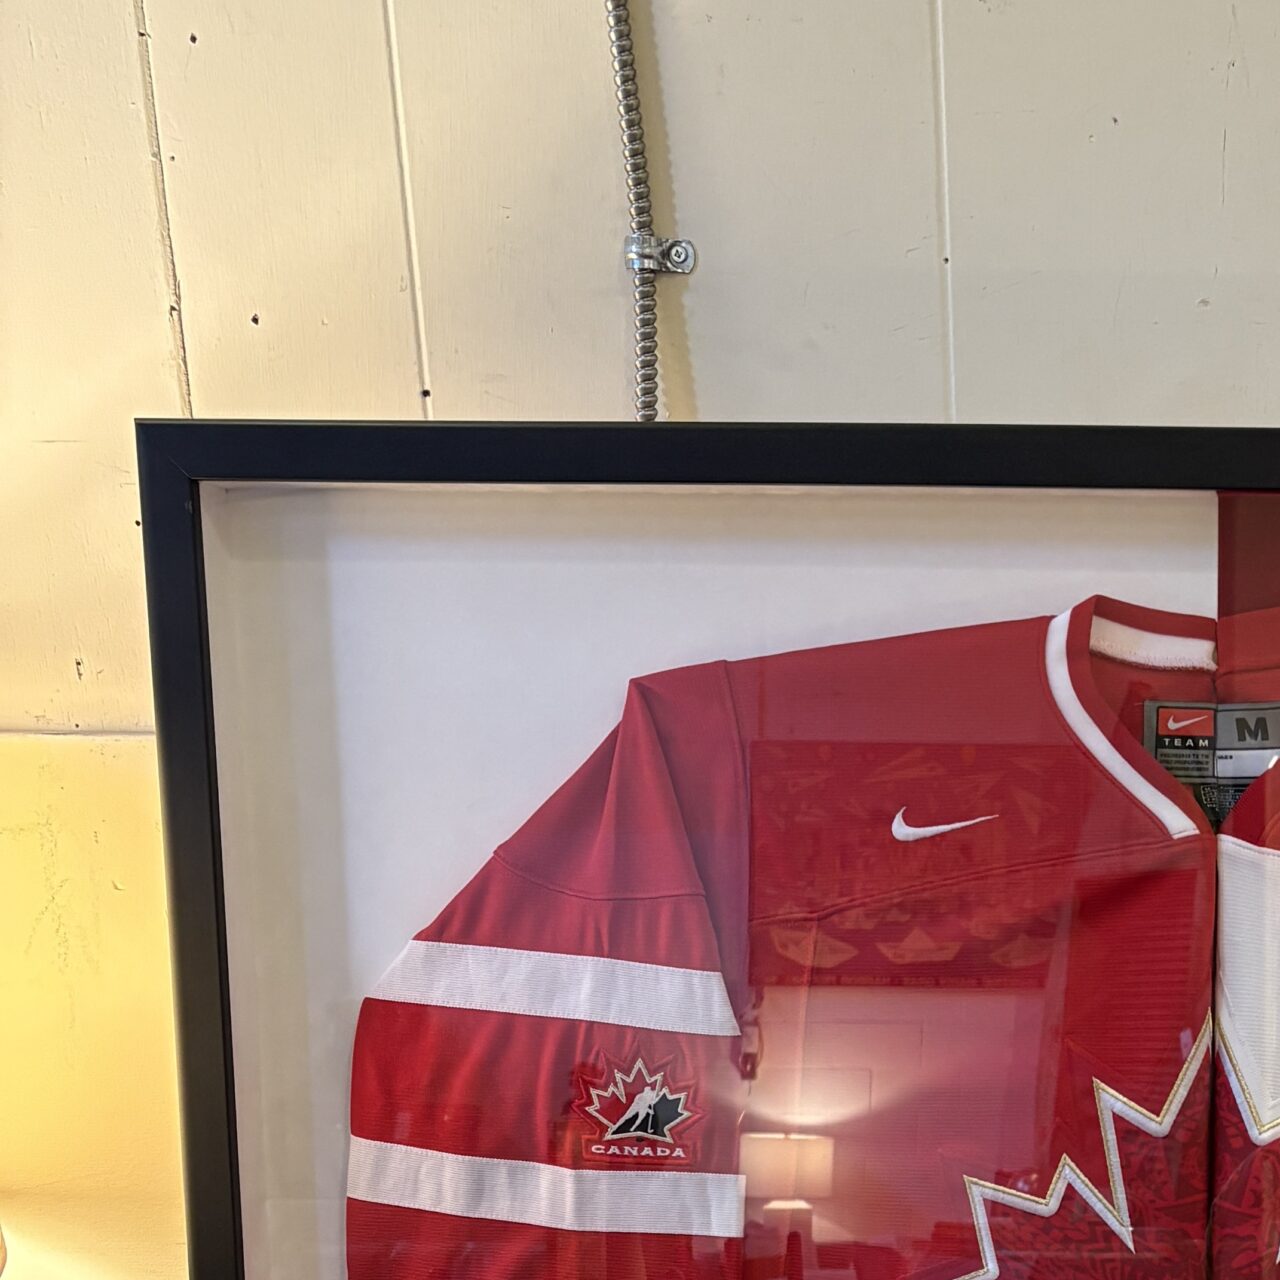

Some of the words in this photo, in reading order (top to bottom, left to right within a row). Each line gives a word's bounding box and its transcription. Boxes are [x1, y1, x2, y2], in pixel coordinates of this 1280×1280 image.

[1235, 716, 1269, 742] M
[1163, 738, 1209, 747] TEAM
[590, 1145, 686, 1158] CANADA
